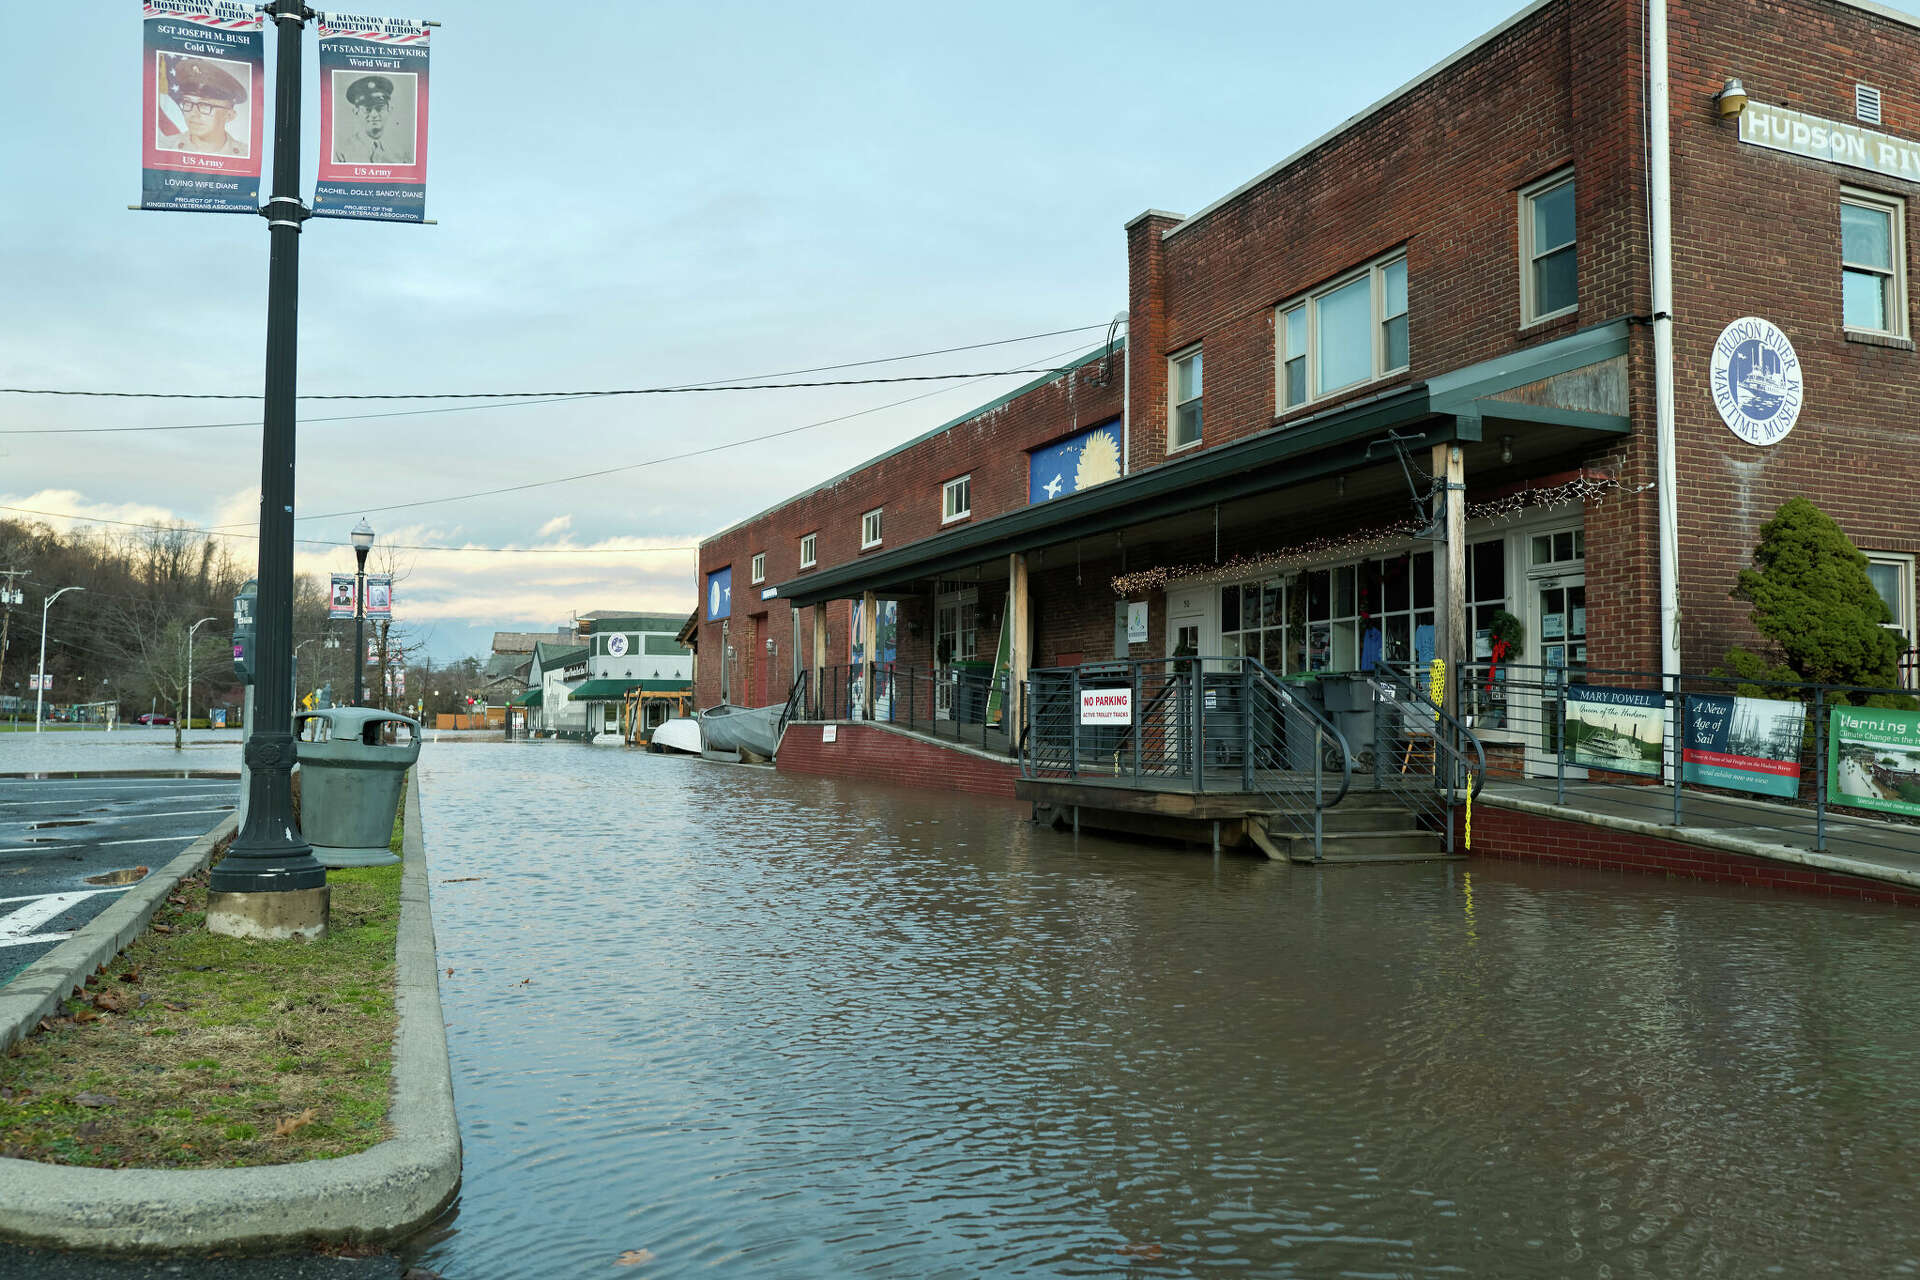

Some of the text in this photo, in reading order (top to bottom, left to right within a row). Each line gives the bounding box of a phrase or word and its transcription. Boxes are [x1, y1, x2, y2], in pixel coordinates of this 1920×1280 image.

[153, 1, 254, 20] HOMETOWN HEROES
[220, 0, 243, 11] AREA
[336, 14, 412, 26] KINGSTON AREA
[158, 25, 250, 44] SGT JOSEPH M. BUSH
[327, 21, 421, 35] HOMETOWN HEROES
[184, 42, 224, 54] Cold War
[321, 44, 428, 57] PVT STANLEY T. NEWKIRK
[350, 58, 400, 68] World War II
[1747, 111, 1866, 160] HUDSON
[182, 156, 224, 168] US Army
[354, 168, 392, 178] US Army
[165, 178, 238, 190] LOVING WIFE DIANE
[318, 187, 348, 195] RACHEL,
[1719, 322, 1796, 372] HUDSON RIVER
[1715, 367, 1799, 440] MARITIME MUSEUM
[1084, 696, 1127, 706] NO PARKING
[1580, 691, 1651, 705] MARY POWELL
[1579, 704, 1647, 719] Queen of the Hudson
[1692, 702, 1726, 715] A New
[1693, 717, 1722, 732] Age of
[1840, 714, 1907, 734] Warning
[1696, 732, 1714, 744] Sail
[1840, 730, 1863, 738] Climate
[1864, 732, 1891, 741] Change
[1902, 735, 1912, 744] the
